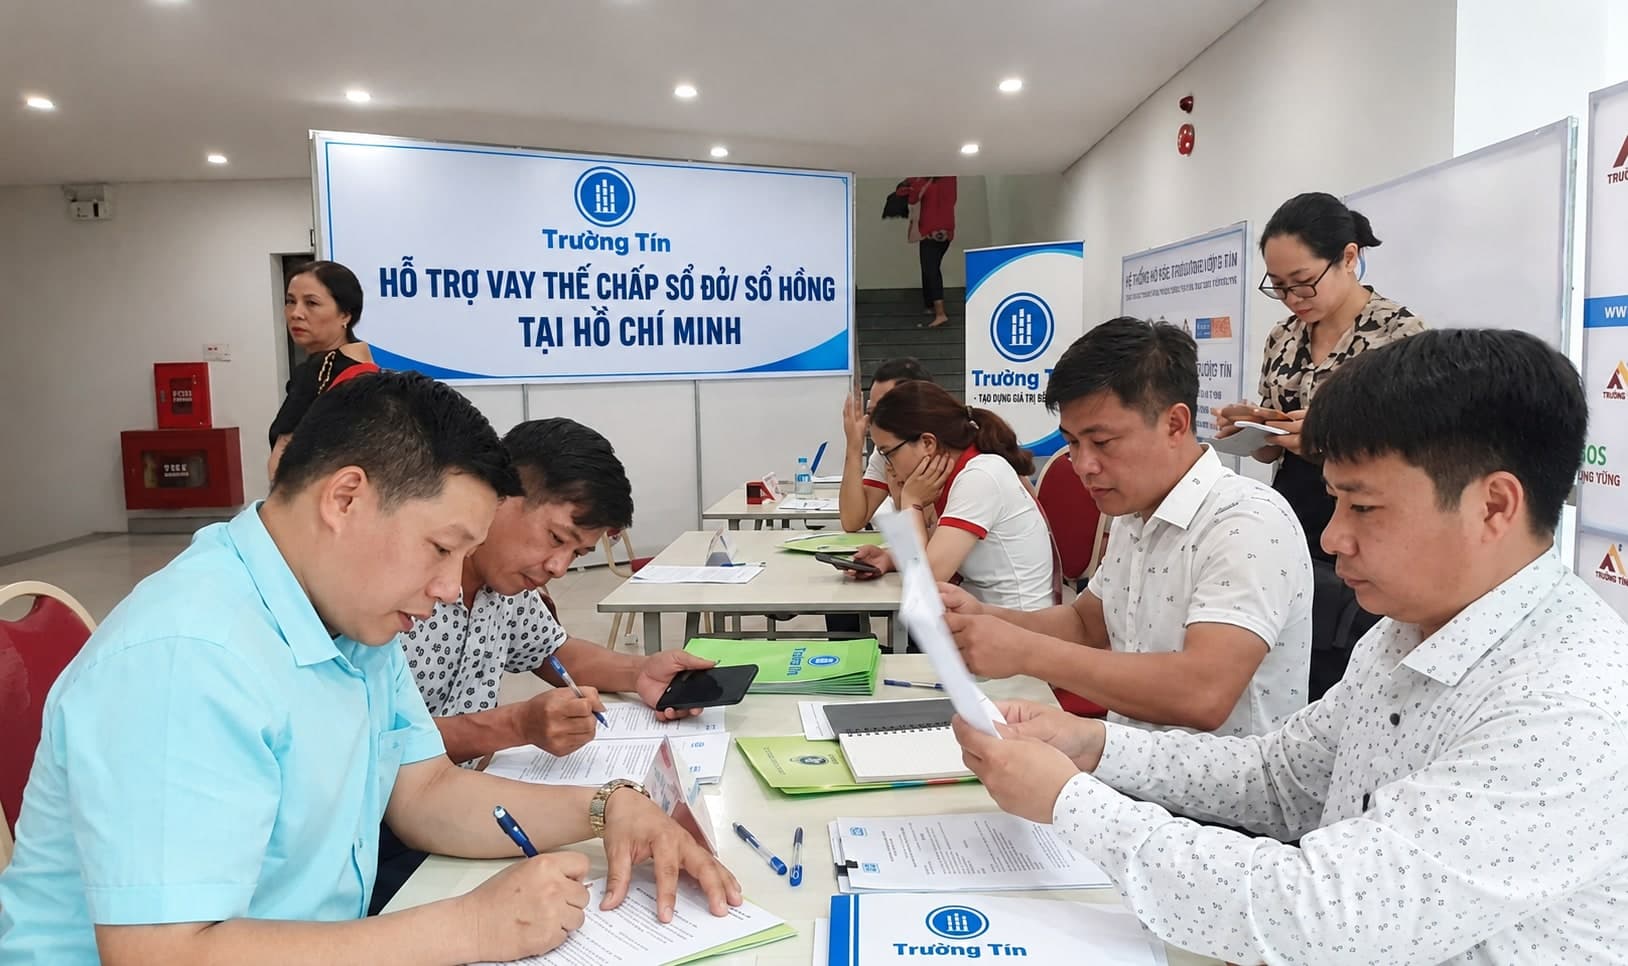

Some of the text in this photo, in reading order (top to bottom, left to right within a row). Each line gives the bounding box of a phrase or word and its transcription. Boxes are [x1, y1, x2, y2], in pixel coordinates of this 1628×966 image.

[542, 228, 671, 256] Trường Tín
[379, 255, 418, 298] HỖ
[425, 268, 480, 306] TRỢ
[486, 270, 536, 299] VAY
[542, 262, 592, 300] THẾ
[596, 263, 659, 300] CHẤP
[665, 263, 695, 301] SỔ
[744, 264, 772, 302] SỔ
[778, 266, 836, 302] HỒNG
[518, 305, 741, 355] TẠI HỒ CHÍ MINH
[972, 369, 1039, 390] Trường
[892, 942, 1027, 959] Trường Tín
